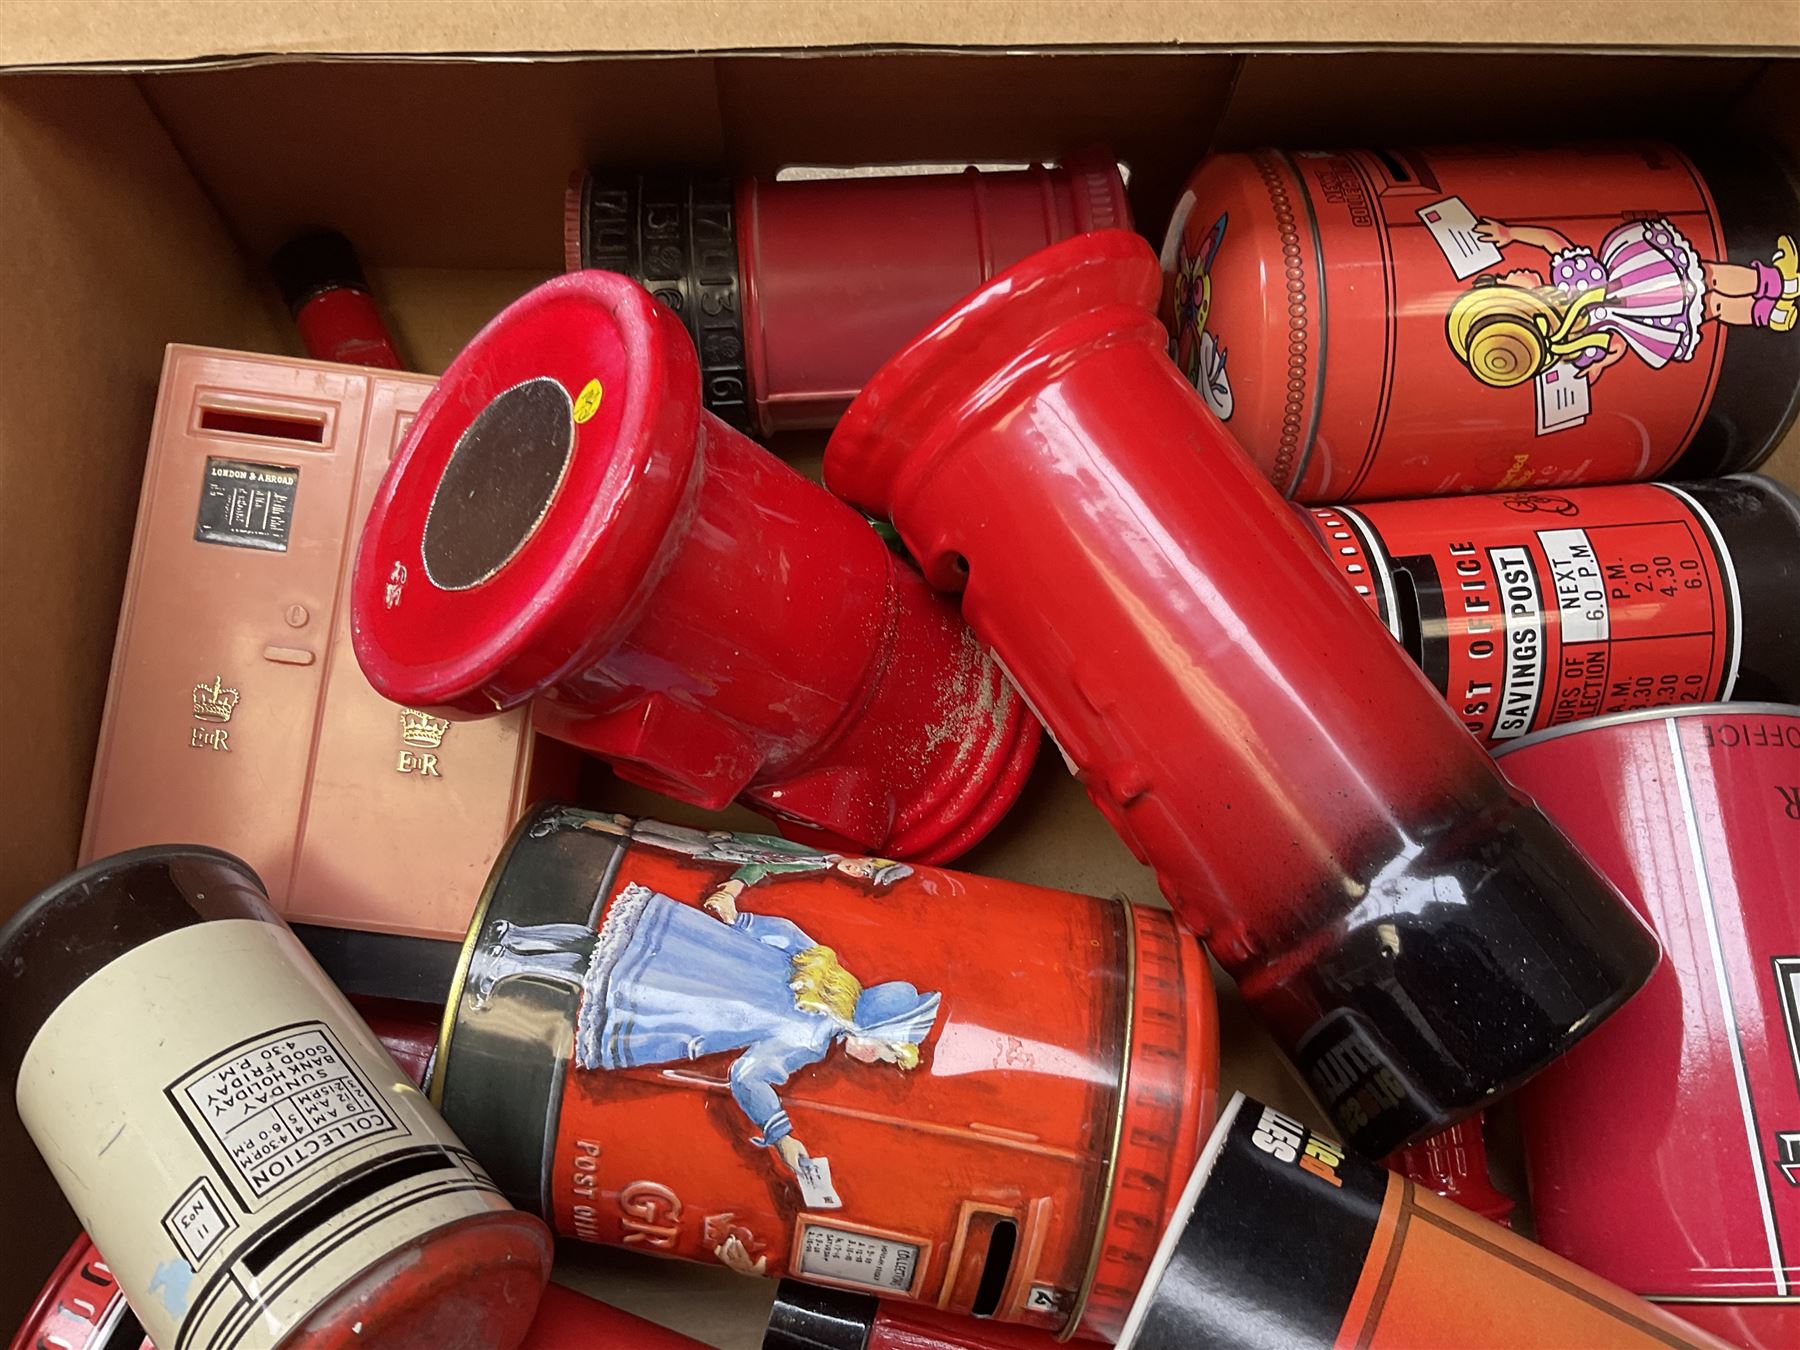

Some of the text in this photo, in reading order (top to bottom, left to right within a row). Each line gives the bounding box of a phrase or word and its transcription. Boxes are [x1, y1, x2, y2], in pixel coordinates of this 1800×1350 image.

[211, 467, 247, 479] LONDON
[249, 472, 256, 481] &
[1552, 558, 1581, 609] NEXT
[1607, 557, 1630, 599] P.M.
[1635, 563, 1653, 592] 2.0
[1653, 556, 1675, 597] 4.30
[1680, 559, 1702, 590] 6.0
[1585, 590, 1605, 621] 6.0
[1450, 541, 1493, 734] OST OFFICE
[1500, 557, 1536, 730] SAVINGS POST
[1565, 657, 1584, 679] OF
[205, 1043, 328, 1105] GOOD FRIDAY
[212, 1055, 335, 1115] BANK HOLIDAY
[240, 1068, 327, 1115] SUNDAY
[347, 1079, 355, 1088] 3
[336, 1092, 350, 1103] 12
[346, 1103, 356, 1113] 9
[354, 1089, 363, 1098] 2
[288, 1114, 297, 1124] 5
[296, 1126, 305, 1135] 4
[251, 1113, 385, 1189] COLLECTION
[574, 1139, 599, 1198] POST
[620, 1180, 682, 1248] GR
